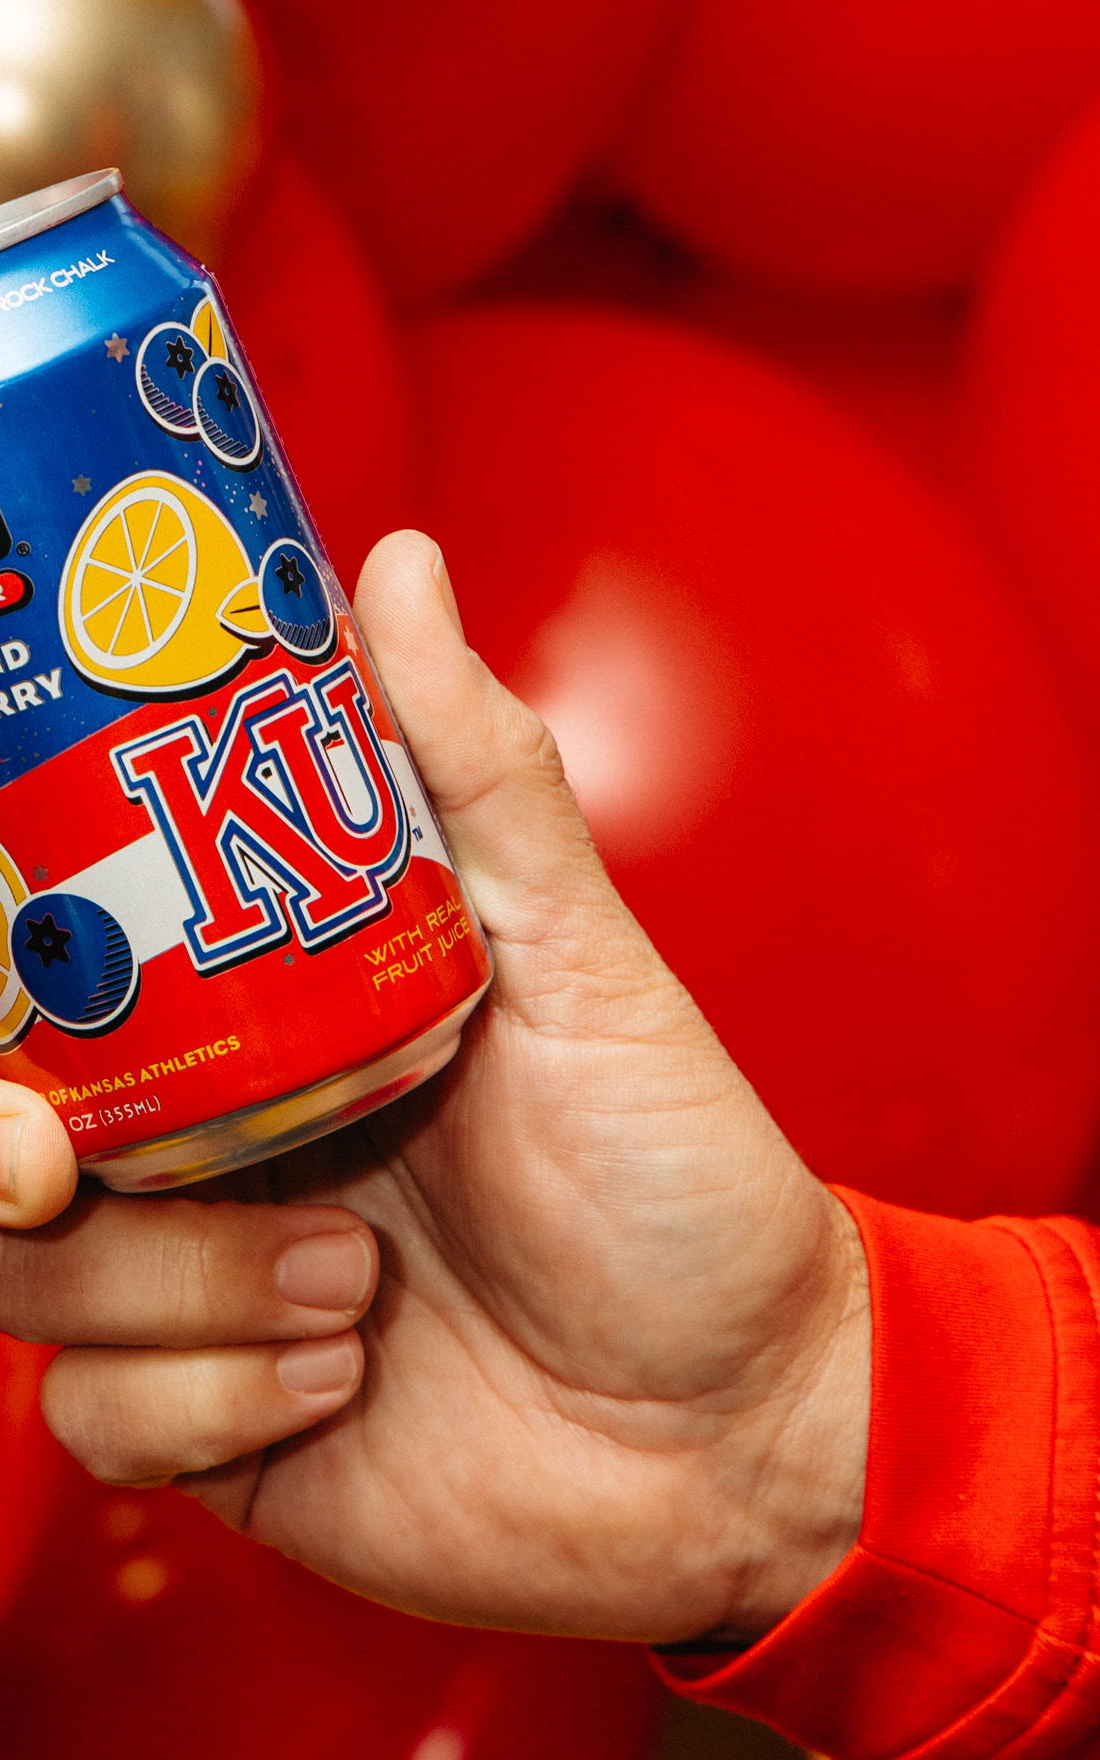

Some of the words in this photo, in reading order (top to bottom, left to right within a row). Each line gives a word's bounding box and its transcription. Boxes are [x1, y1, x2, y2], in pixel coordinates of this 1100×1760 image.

[50, 249, 115, 289] CHALK
[109, 656, 408, 971] KU
[364, 924, 424, 966] WITH
[426, 896, 462, 932] REAL
[372, 943, 433, 991] FRUIT
[437, 916, 470, 957] JUICE
[49, 1088, 68, 1106] OF
[69, 1072, 136, 1103] KANSAS
[140, 1035, 241, 1084] ATHLETICS
[69, 1113, 98, 1132] OZ
[99, 1094, 162, 1127] (355ML)
